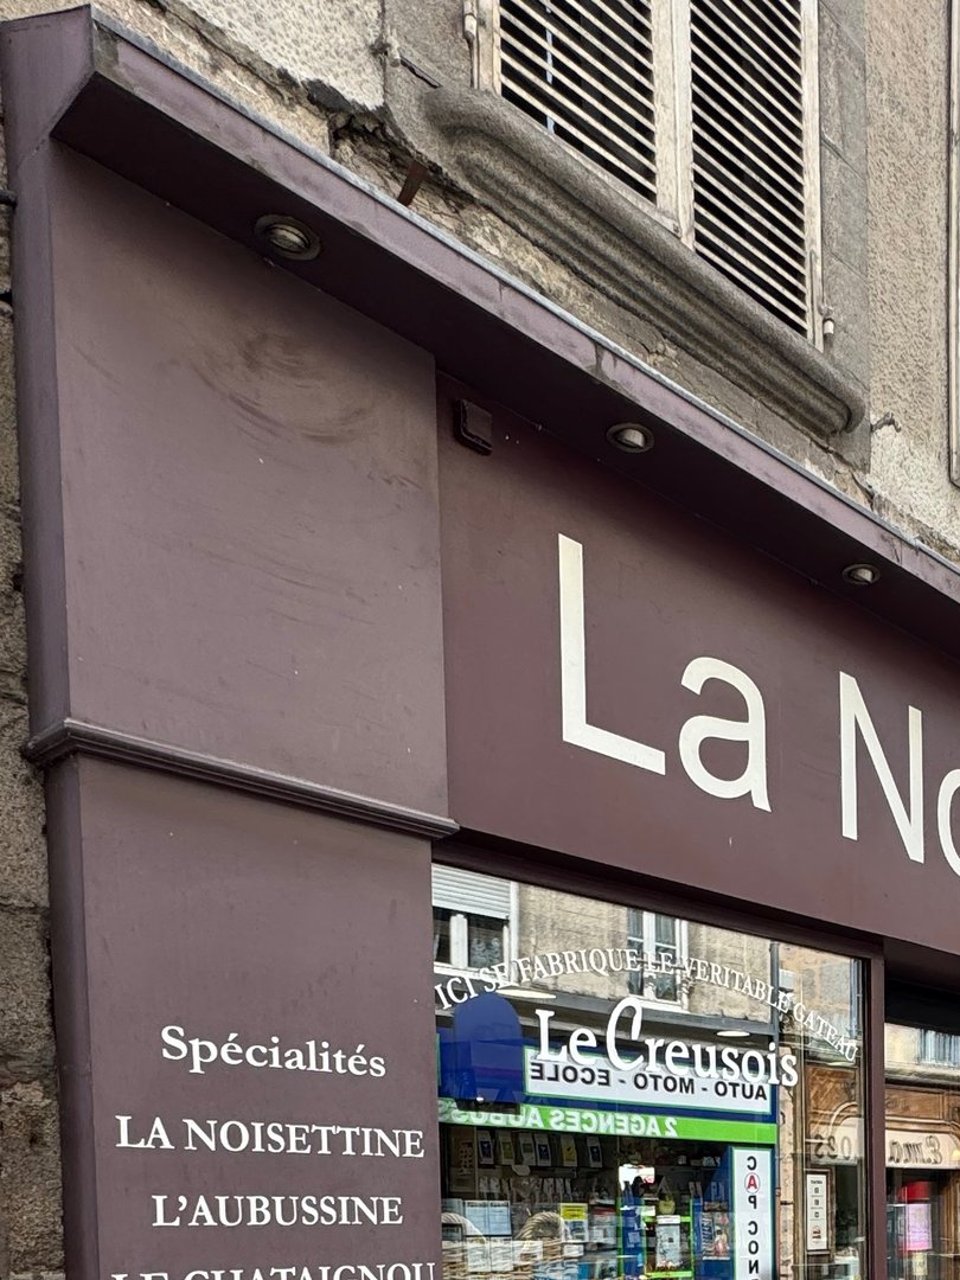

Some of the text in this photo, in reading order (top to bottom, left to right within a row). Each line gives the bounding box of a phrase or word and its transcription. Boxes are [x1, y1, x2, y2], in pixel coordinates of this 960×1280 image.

[558, 533, 772, 813] La
[434, 949, 859, 1062] ICI SE FABRIQUE LE VERITABLE GATEAU
[161, 1025, 386, 1077] Spécialités
[115, 1115, 425, 1158] LA NOISETTINE
[151, 1194, 404, 1227] L'AUBUSSINE
